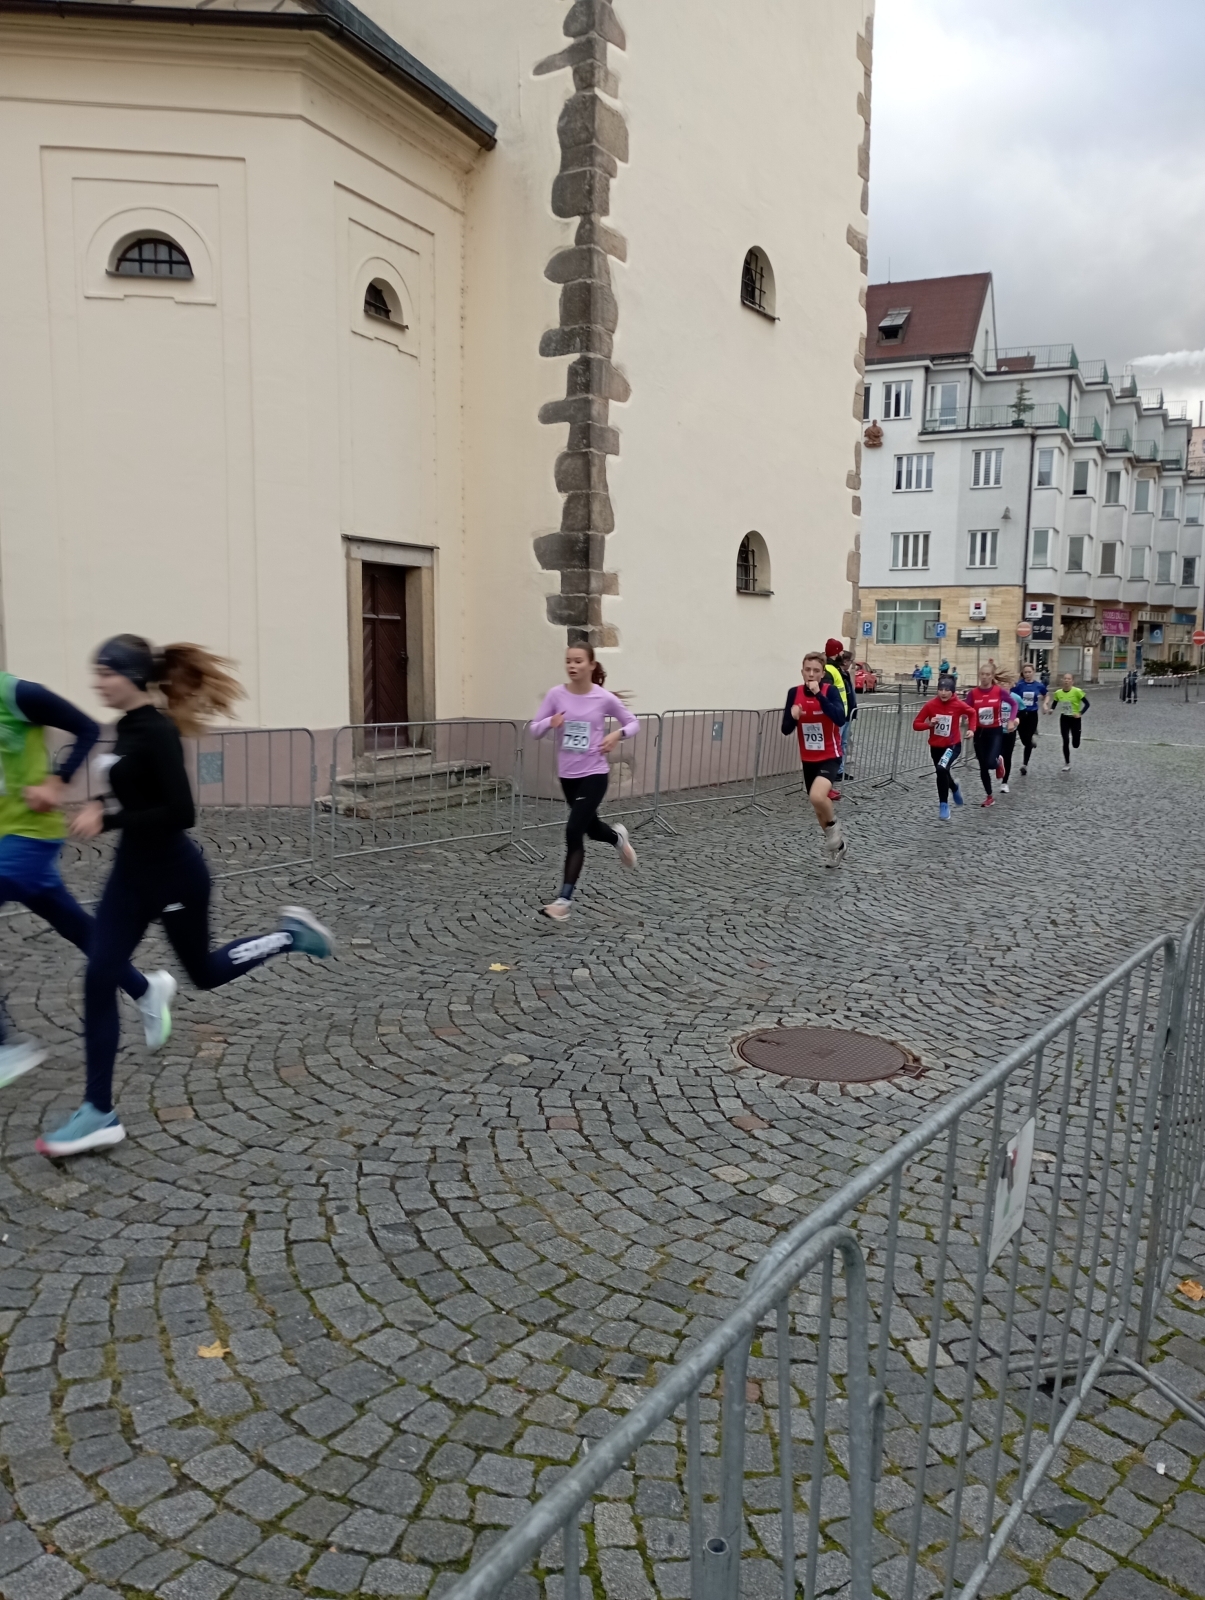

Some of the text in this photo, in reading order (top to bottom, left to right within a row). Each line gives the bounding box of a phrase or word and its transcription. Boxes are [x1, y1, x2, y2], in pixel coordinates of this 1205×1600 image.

[864, 623, 871, 631] P
[937, 624, 944, 633] P
[804, 733, 823, 742] 703
